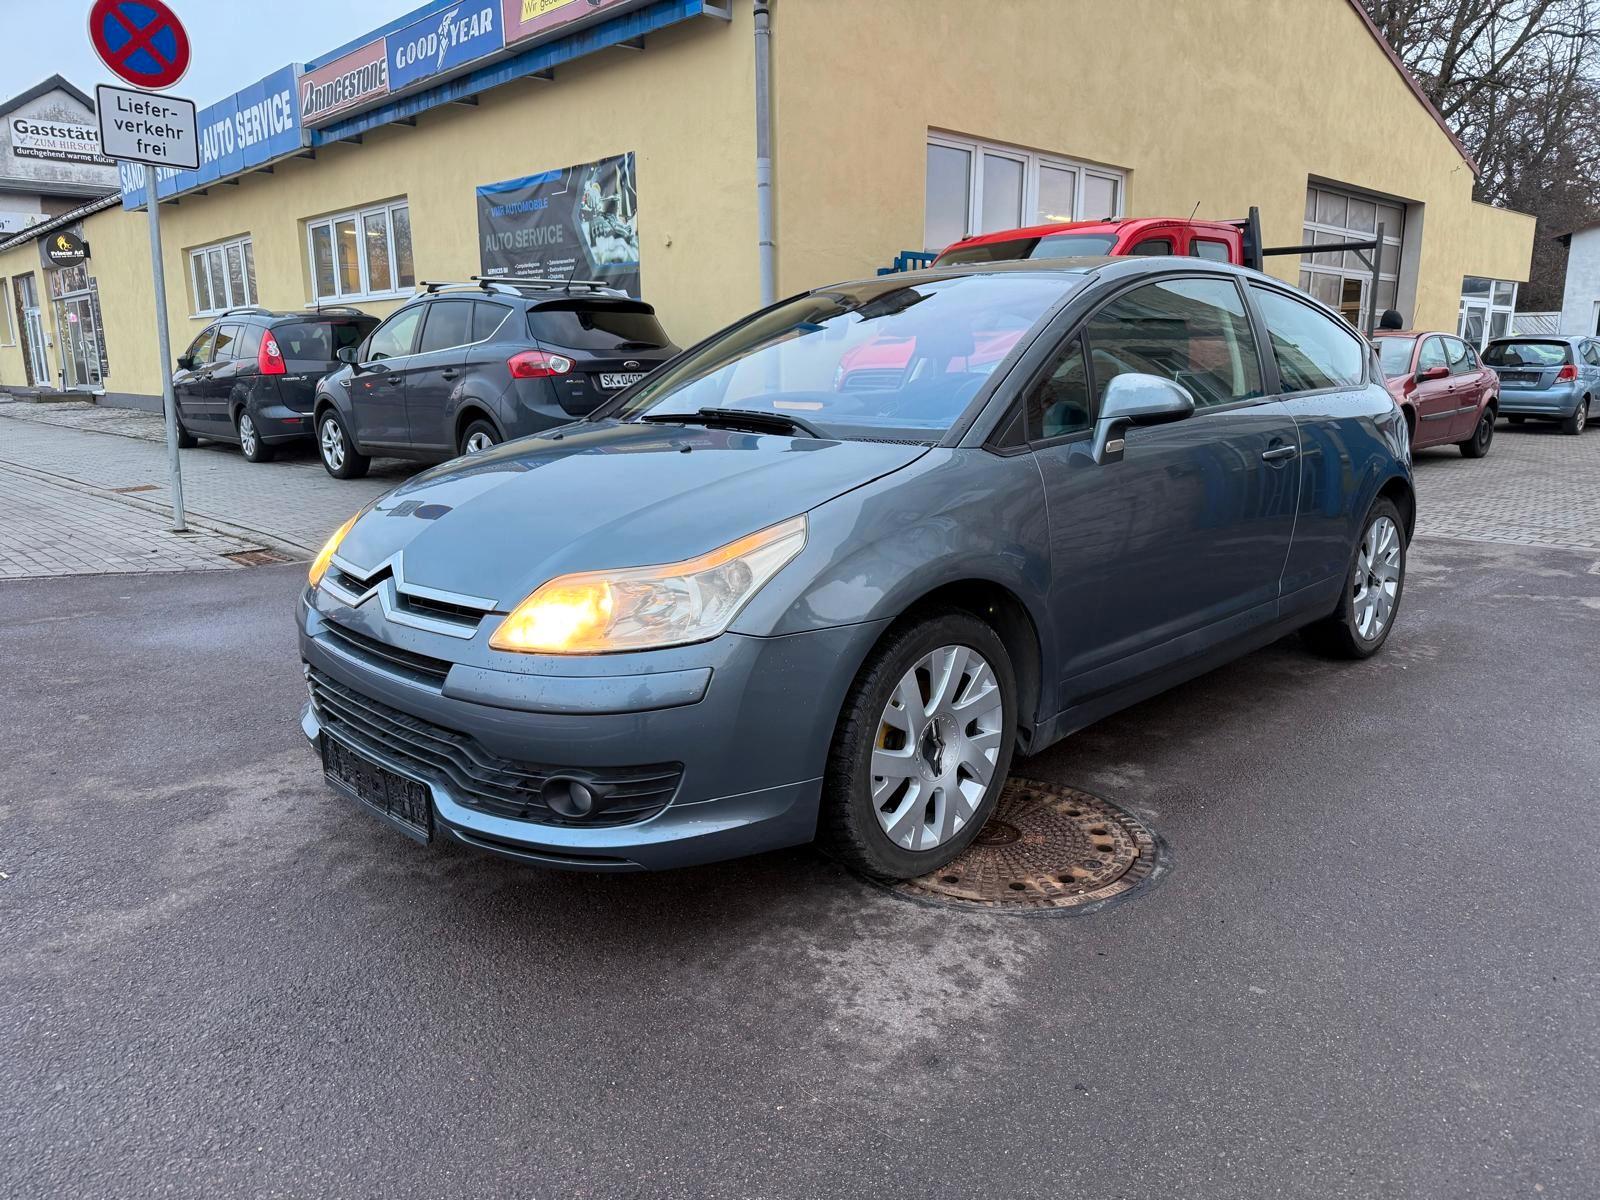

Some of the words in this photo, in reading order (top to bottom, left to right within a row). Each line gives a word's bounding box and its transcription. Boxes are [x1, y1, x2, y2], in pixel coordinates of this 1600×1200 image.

[303, 57, 386, 118] BRIDGESTONE
[117, 95, 178, 118] Liefer-
[13, 119, 99, 141] Gaststätt
[113, 118, 184, 140] verkehr
[203, 117, 234, 164] AUTO
[235, 89, 293, 149] SERVICE
[17, 148, 65, 158] durchgehend
[67, 152, 92, 162] warme
[136, 138, 167, 157] frei
[485, 232, 513, 252] AUTO
[515, 223, 564, 248] SERVICE
[603, 374, 616, 386] SK
